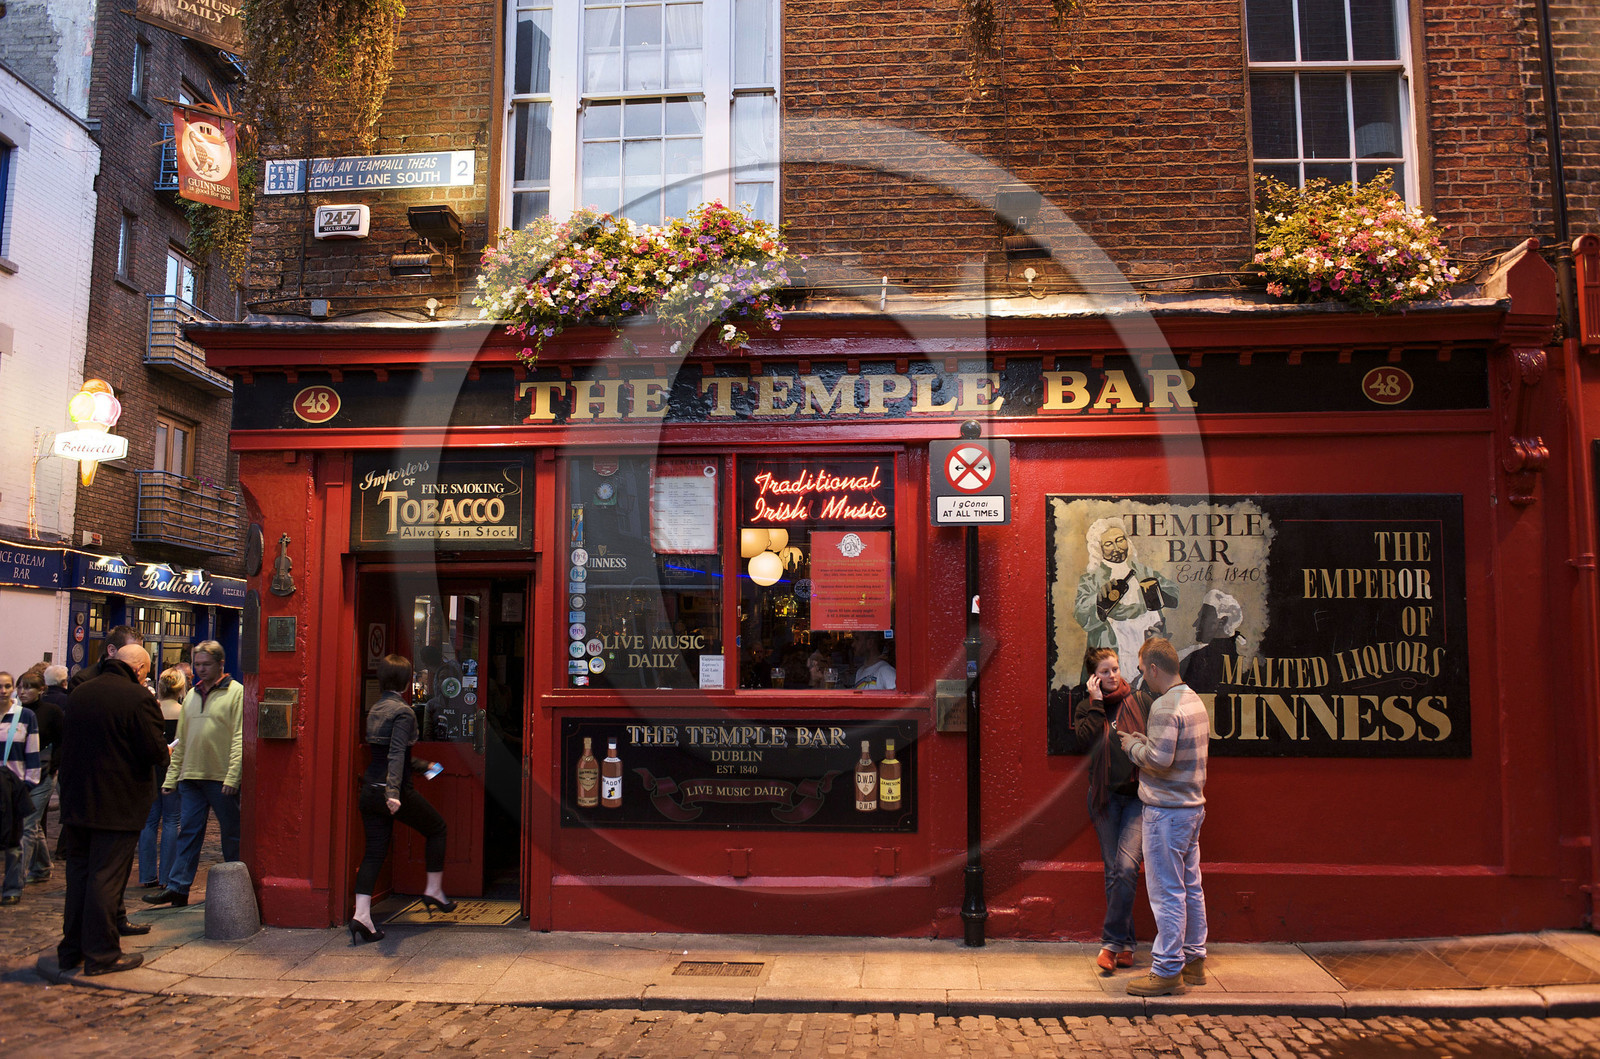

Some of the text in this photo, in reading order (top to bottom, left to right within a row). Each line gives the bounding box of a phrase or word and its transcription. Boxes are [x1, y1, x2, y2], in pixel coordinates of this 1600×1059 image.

[177, 0, 226, 23] DAILY
[337, 161, 353, 172] AN
[356, 158, 406, 172] TEAMPAILL
[407, 157, 438, 169] THEAS
[457, 160, 469, 176] 2
[187, 178, 231, 194] GUINNESS
[308, 171, 441, 188] TEMPLE LANE SOUTH
[324, 211, 356, 225] 24-7
[1368, 372, 1401, 396] 48
[301, 391, 331, 413] 48
[517, 368, 1199, 421] THE TEMPLE BAR
[359, 460, 430, 490] Importers
[403, 478, 416, 486] OF
[754, 466, 881, 495] Traditional
[421, 483, 505, 494] FINE SMOKING
[377, 490, 505, 535] TOBACCO
[751, 495, 887, 522] Irish Music
[974, 509, 999, 517] TIMES
[402, 526, 515, 538] Always in Stock
[1123, 513, 1265, 537] TEMPLE
[1166, 539, 1234, 566] BAR
[1374, 531, 1431, 562] THE
[14, 553, 46, 568] CREAM
[88, 560, 133, 575] RISTORANTE
[586, 558, 627, 568] UINNESS
[13, 567, 30, 580] BAR
[52, 573, 59, 583] 2
[81, 576, 86, 585] 3
[1224, 567, 1261, 582] 1840
[139, 571, 214, 597] Botticelli
[1302, 568, 1433, 600] EMPEROR
[222, 587, 245, 598] PIZZERIA
[1401, 606, 1433, 637] OF
[603, 635, 705, 649] LIVE MUSIC
[628, 654, 679, 668] DAILY
[1334, 640, 1447, 683] LIQUORS
[1219, 653, 1329, 689] MALTED
[1197, 693, 1452, 742] UINNESS
[626, 725, 849, 748] THE TEMPLE BAR
[711, 750, 763, 762] DUBLIN
[716, 765, 758, 774] EST. 1840
[687, 785, 788, 797] LIVE MUSIC DAILY
